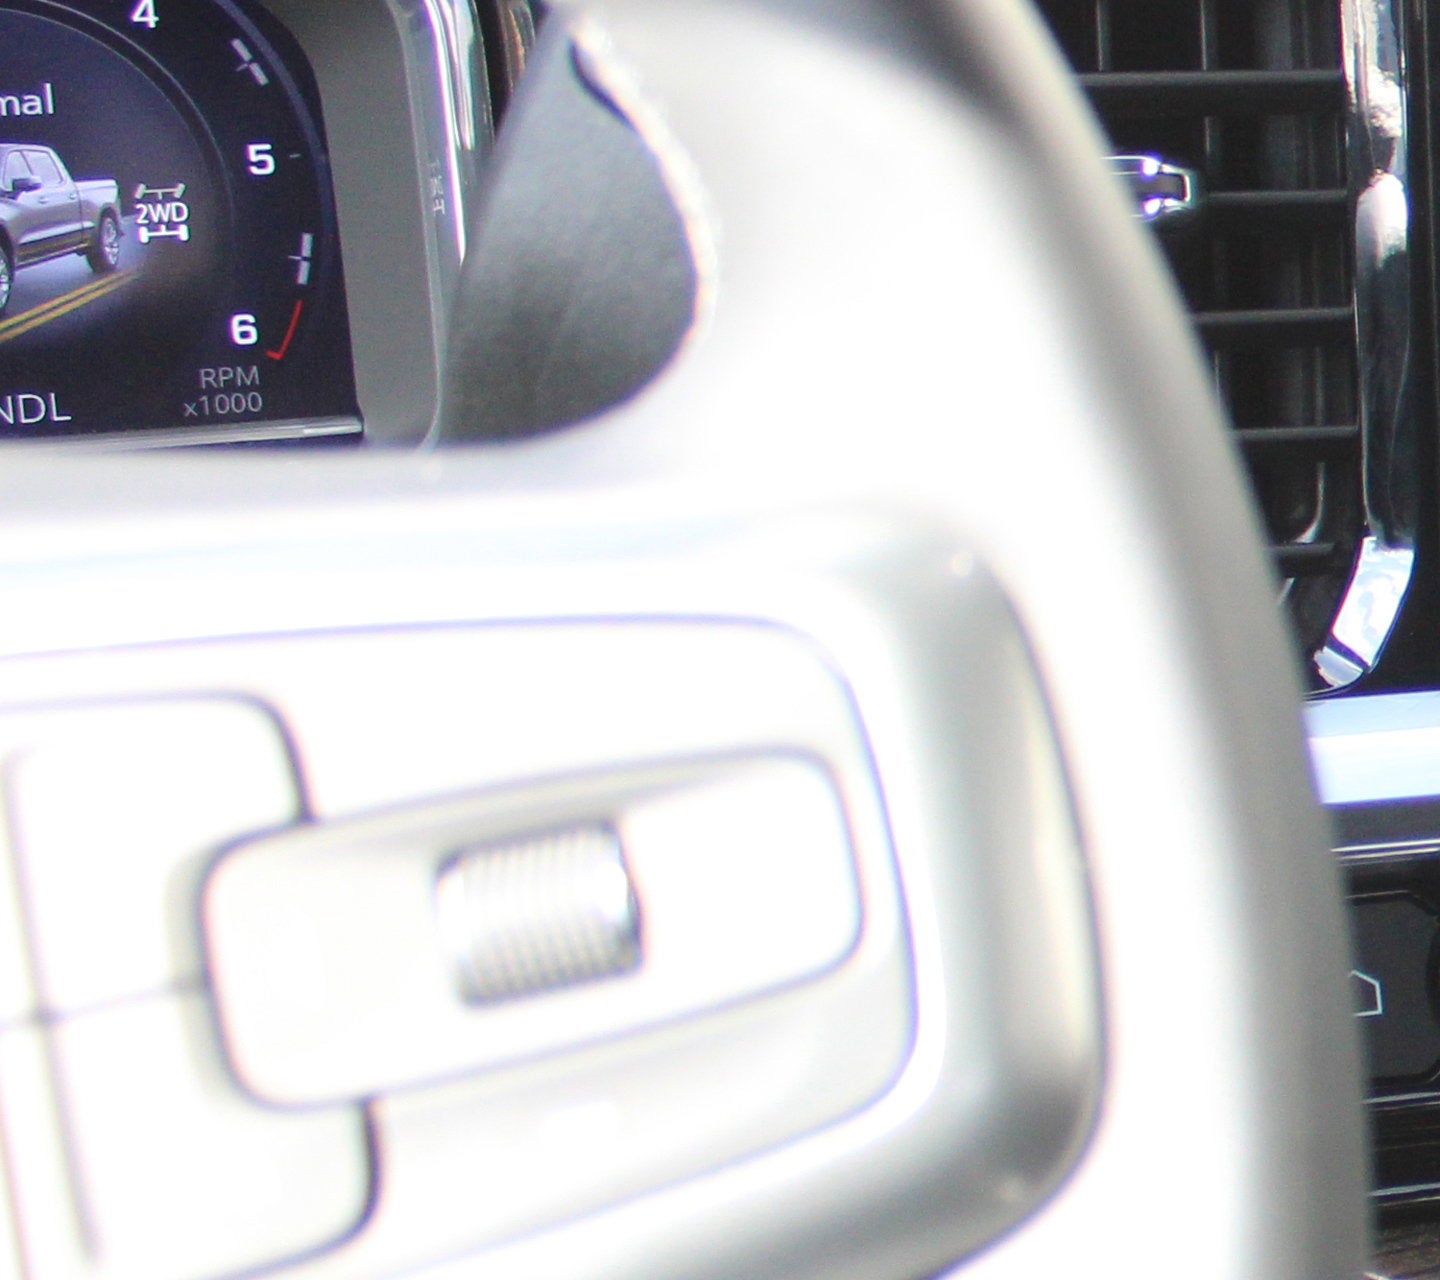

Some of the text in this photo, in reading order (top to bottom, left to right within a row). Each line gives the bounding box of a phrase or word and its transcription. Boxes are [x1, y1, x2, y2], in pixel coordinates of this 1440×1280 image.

[248, 143, 276, 175] 5
[134, 200, 189, 225] 2WD
[231, 313, 258, 345] 6
[199, 365, 260, 389] RPM
